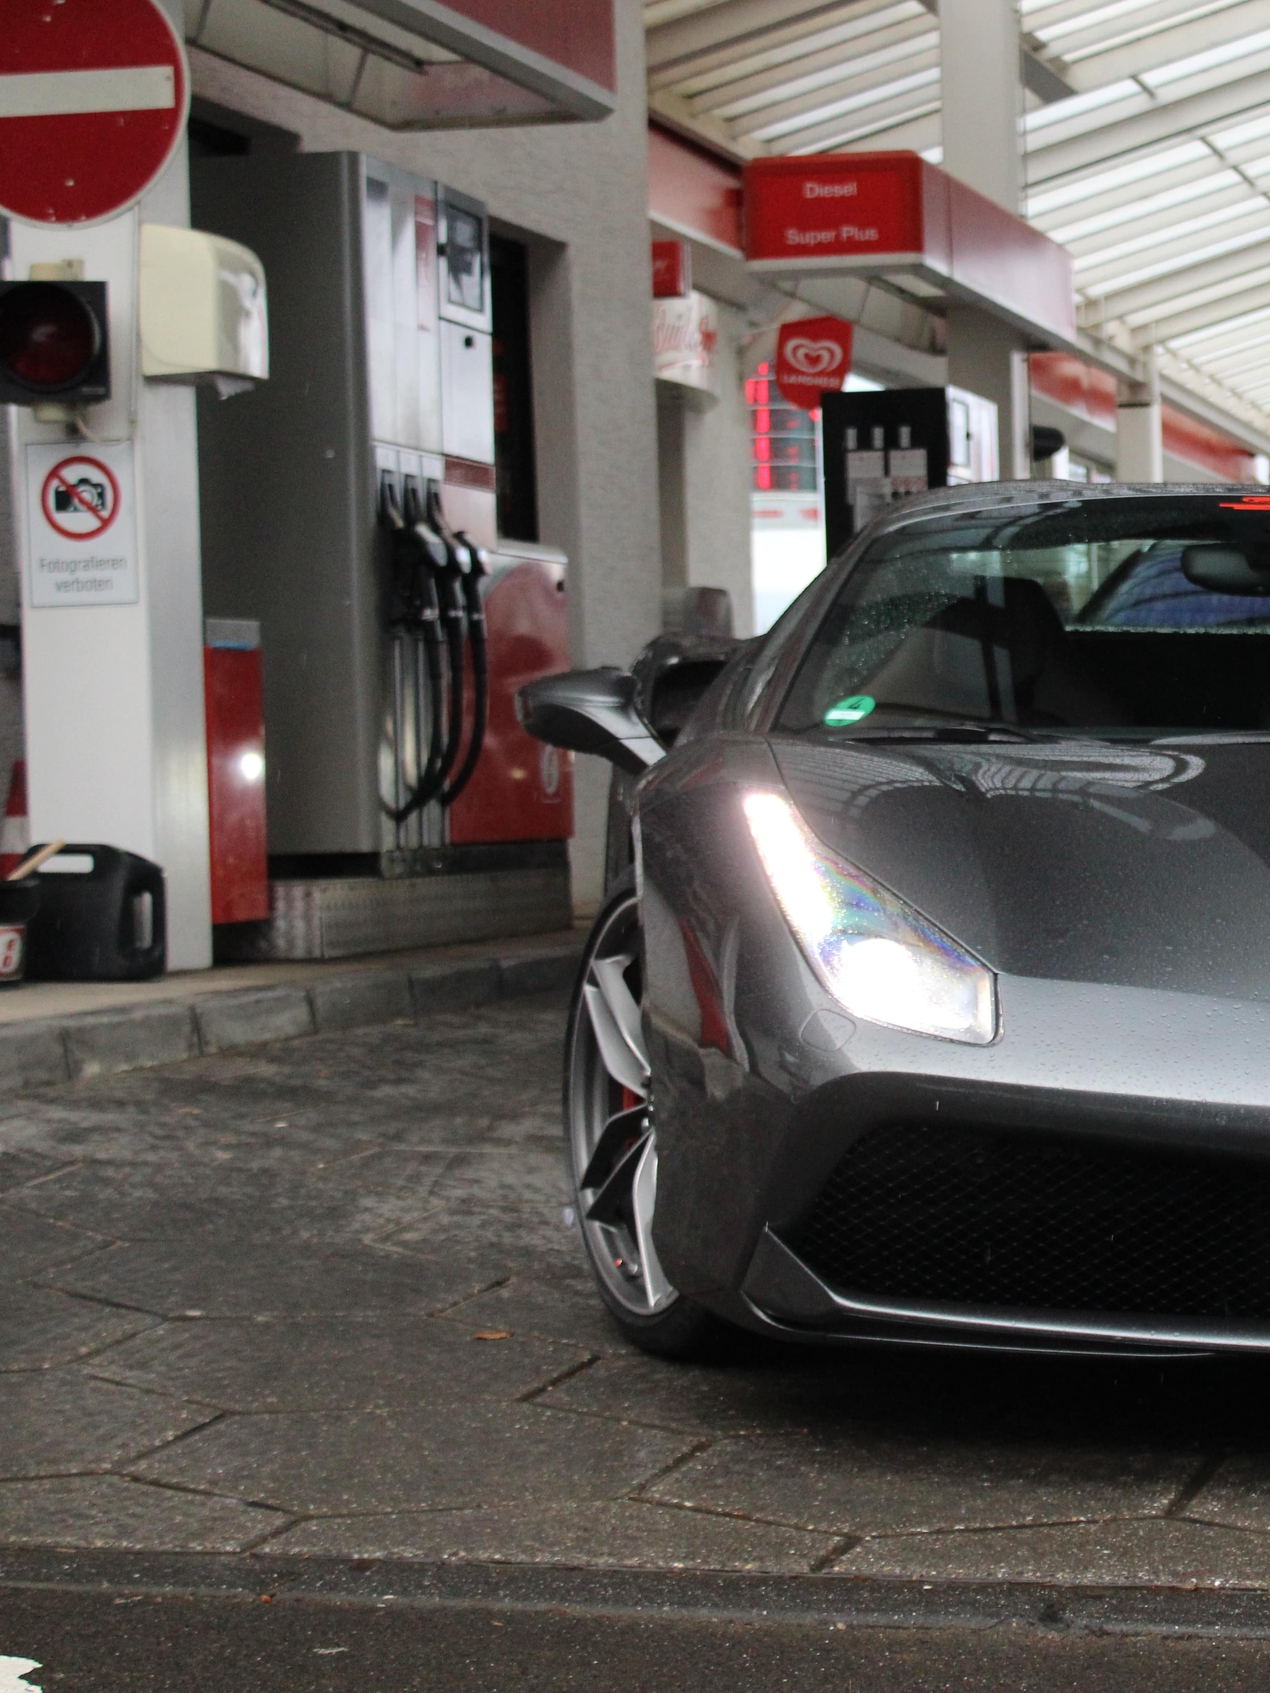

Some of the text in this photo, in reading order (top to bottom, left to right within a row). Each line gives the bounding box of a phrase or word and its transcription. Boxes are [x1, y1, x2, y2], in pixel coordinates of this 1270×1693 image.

[804, 181, 858, 199] Diesel
[785, 225, 879, 246] Super Plus
[39, 556, 127, 575] Fotografieren
[55, 578, 113, 594] verboten
